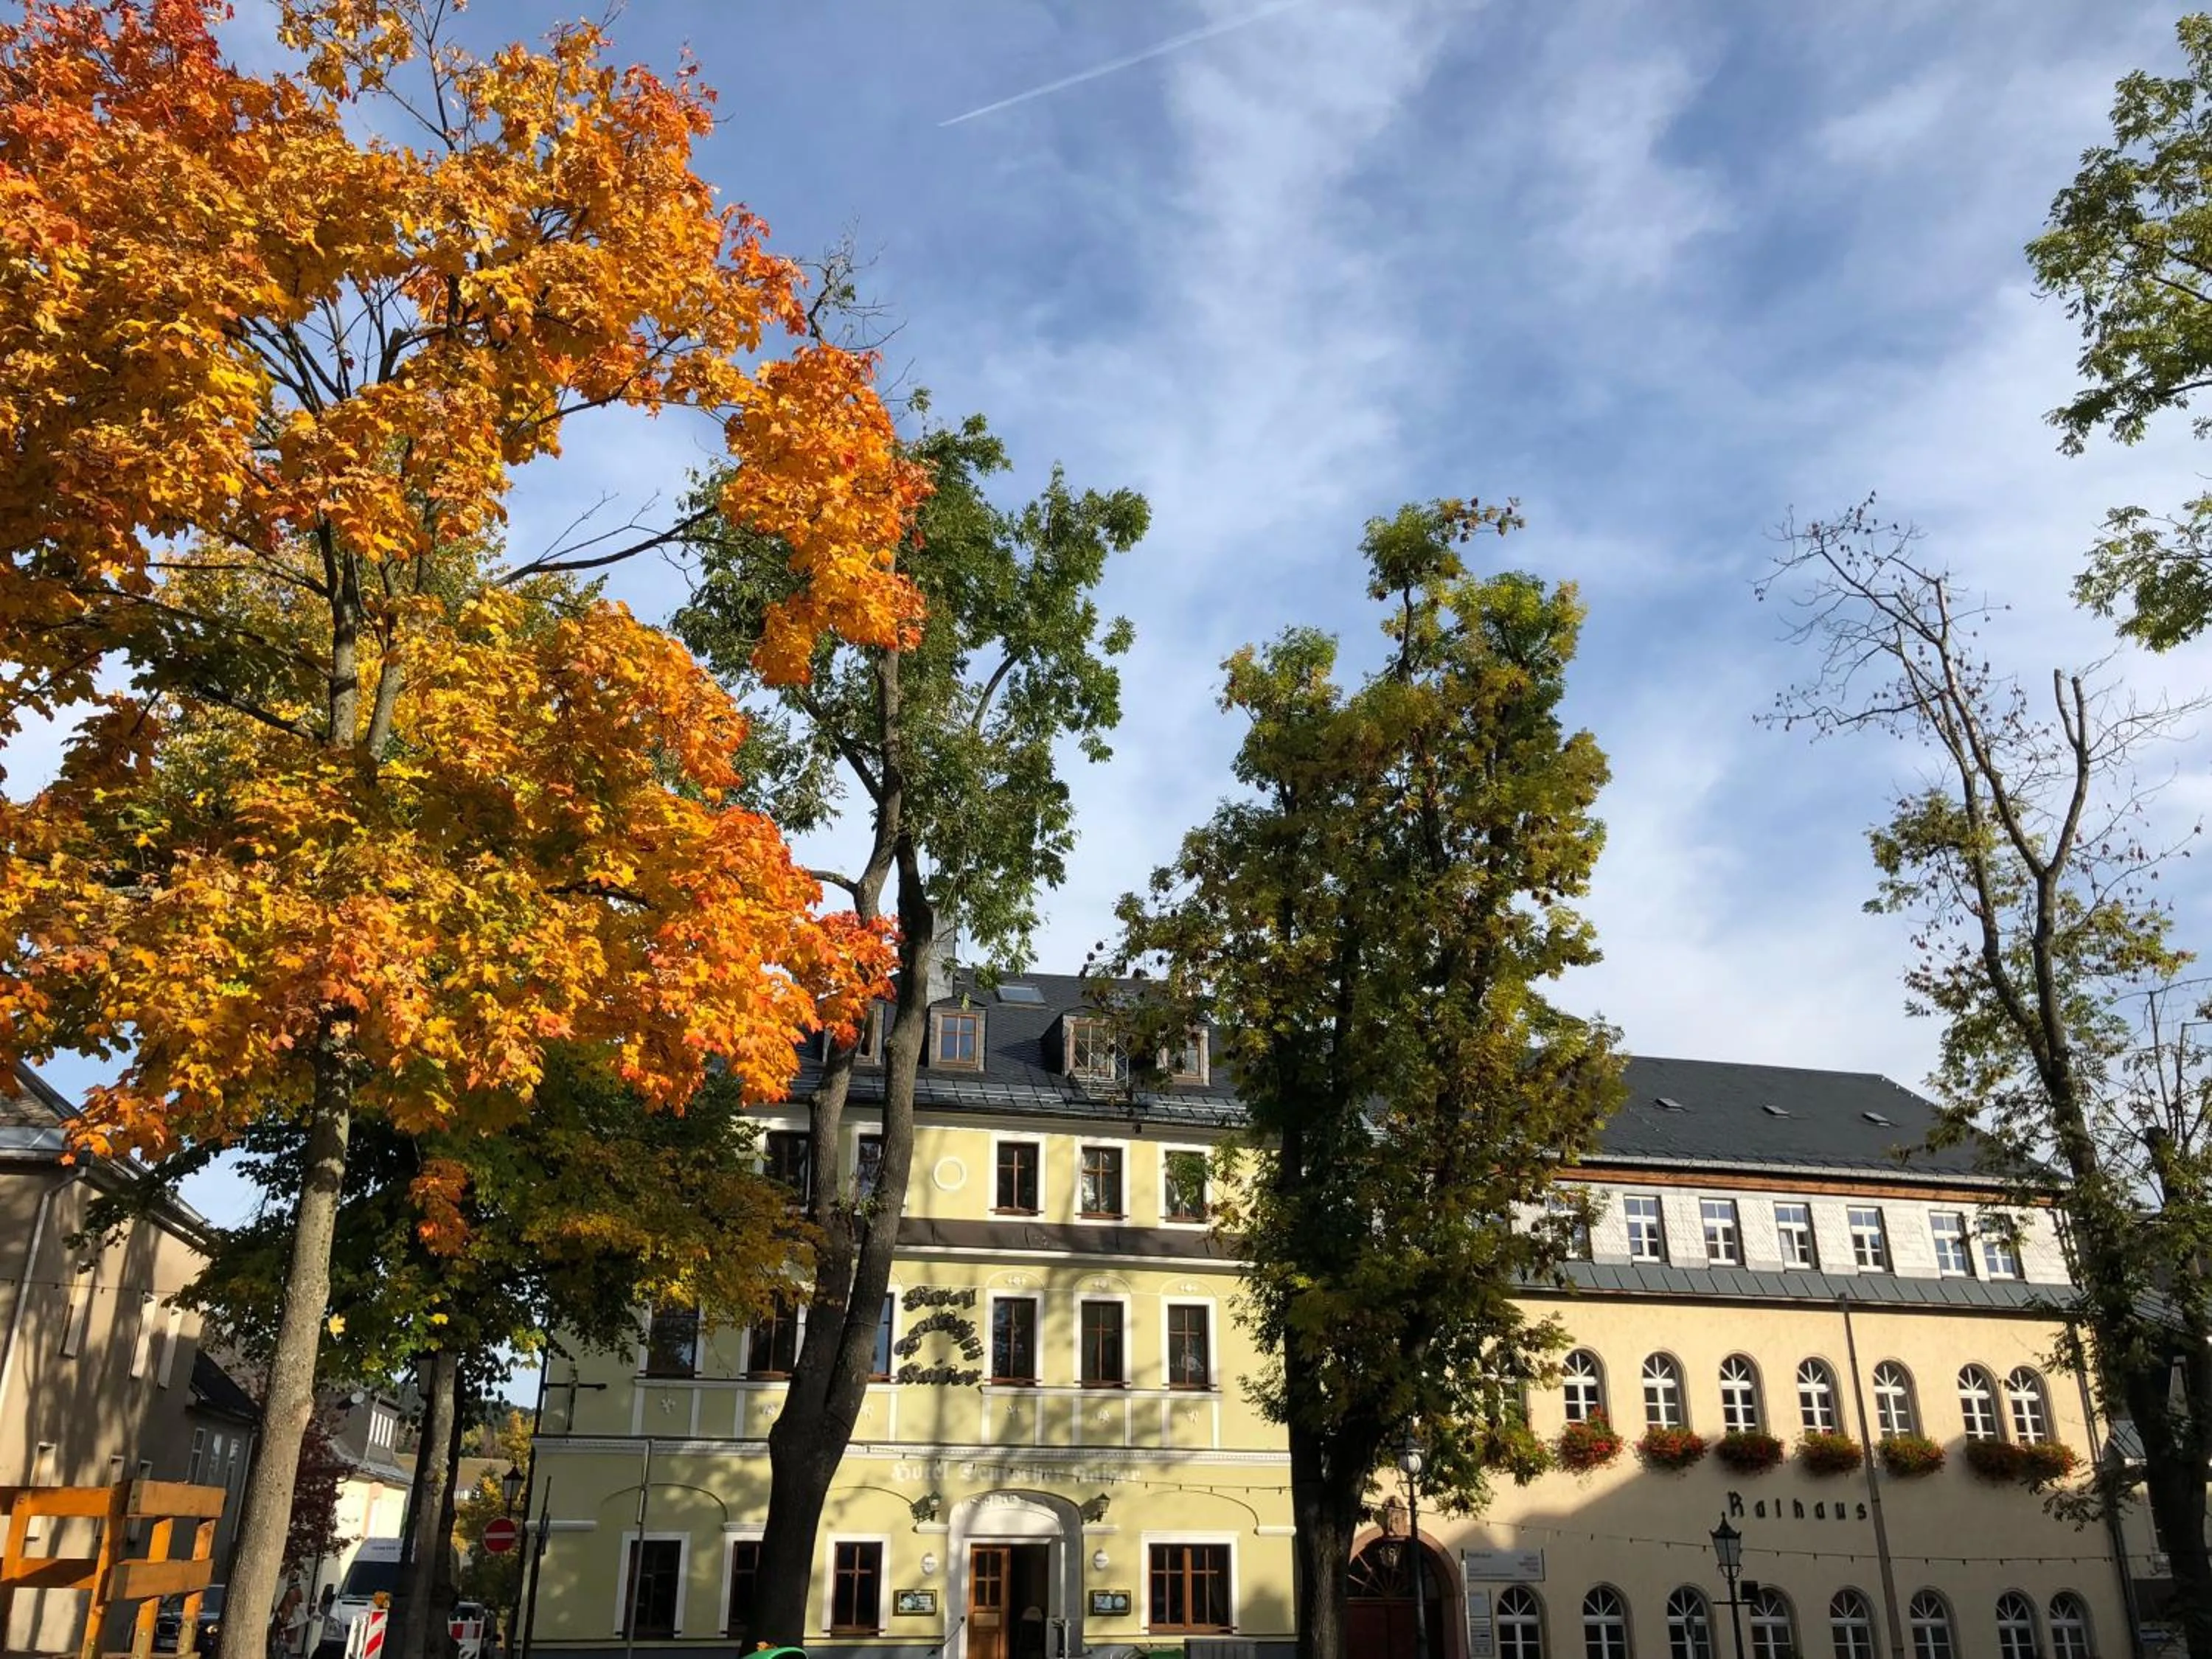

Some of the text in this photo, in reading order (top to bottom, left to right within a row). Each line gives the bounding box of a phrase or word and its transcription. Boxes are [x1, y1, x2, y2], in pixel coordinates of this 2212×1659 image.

[901, 1286, 977, 1312] Hotel
[891, 1461, 950, 1482] Hotel
[1728, 1491, 1868, 1520] Rathaus
